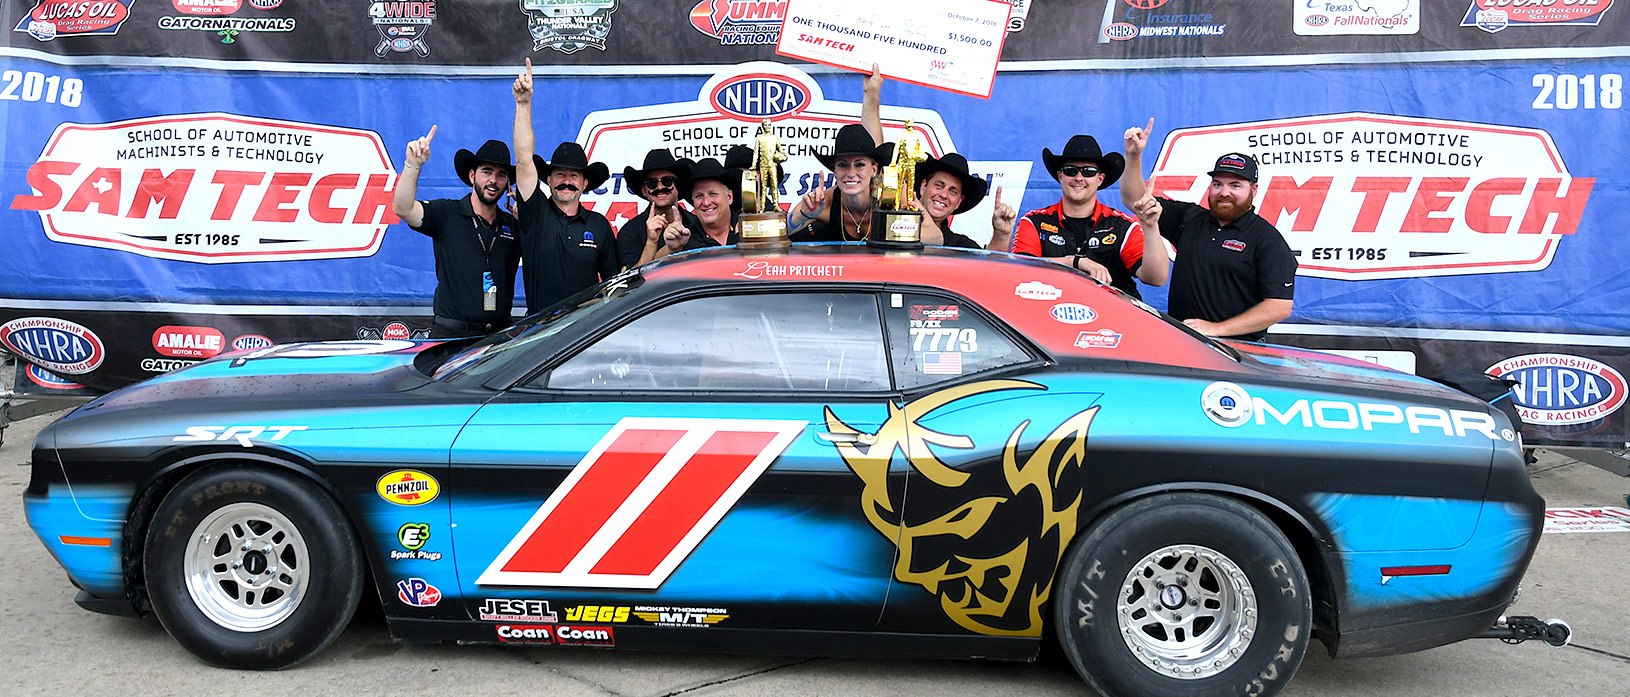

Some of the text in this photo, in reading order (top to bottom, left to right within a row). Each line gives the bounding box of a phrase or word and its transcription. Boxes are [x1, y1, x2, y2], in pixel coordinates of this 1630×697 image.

[38, 1, 118, 20] LUCAS OIL
[1325, 3, 1353, 12] Texas
[159, 19, 295, 30] GATORNATIONALS
[1146, 13, 1213, 24] Insurance
[1334, 15, 1408, 26] FallNationals
[792, 16, 814, 27] ONE
[816, 21, 871, 39] THOUSAND
[873, 34, 896, 45] FIVE
[897, 38, 947, 55] HUNDRED
[1108, 26, 1134, 37] NHRA
[1139, 25, 1224, 36] MIDWEST NATIONALS
[798, 33, 824, 46] SAM
[825, 39, 855, 53] TECH
[948, 32, 993, 48] $1,500.00
[0, 69, 84, 108] 2018
[1531, 73, 1623, 110] 2018
[725, 82, 797, 115] NHRA
[127, 129, 313, 147] SCHOOL OF AUTOMOTIVE
[662, 127, 723, 142] SCHOOL
[729, 126, 749, 139] OF
[1248, 131, 1469, 148] SCHOOL OF AUTOMOTIVE
[116, 146, 324, 165] MACHINISTS & TECHNOLOGY
[1250, 151, 1344, 166] ACHINISTS
[1351, 151, 1360, 162] &
[1367, 150, 1483, 167] TECHNOLOGY
[9, 160, 196, 220] SAM
[1351, 176, 1597, 235] TECH
[175, 234, 240, 246] EST 1985
[1312, 247, 1387, 261] EST 1985
[789, 265, 844, 277] PRITCHETT
[1055, 306, 1094, 320] NHRA
[9, 320, 82, 334] CHAMPIONSHIP
[14, 330, 87, 361] NHRA
[157, 333, 221, 351] AMALIE
[53, 363, 86, 372] RACING
[1503, 357, 1598, 371] CHAMPIONSHIP
[1506, 368, 1602, 407] NHRA
[1546, 408, 1597, 421] RACING
[172, 426, 309, 448] SRT
[385, 481, 430, 495] PENNZOIL
[390, 550, 442, 560] Spark Plugs
[1269, 560, 1297, 599] ET
[1077, 559, 1106, 628] M/T
[480, 600, 553, 617] JESEL
[564, 605, 631, 622] JEGS
[660, 612, 708, 624] M/T
[497, 625, 549, 638] Coan
[557, 626, 609, 639] Coan
